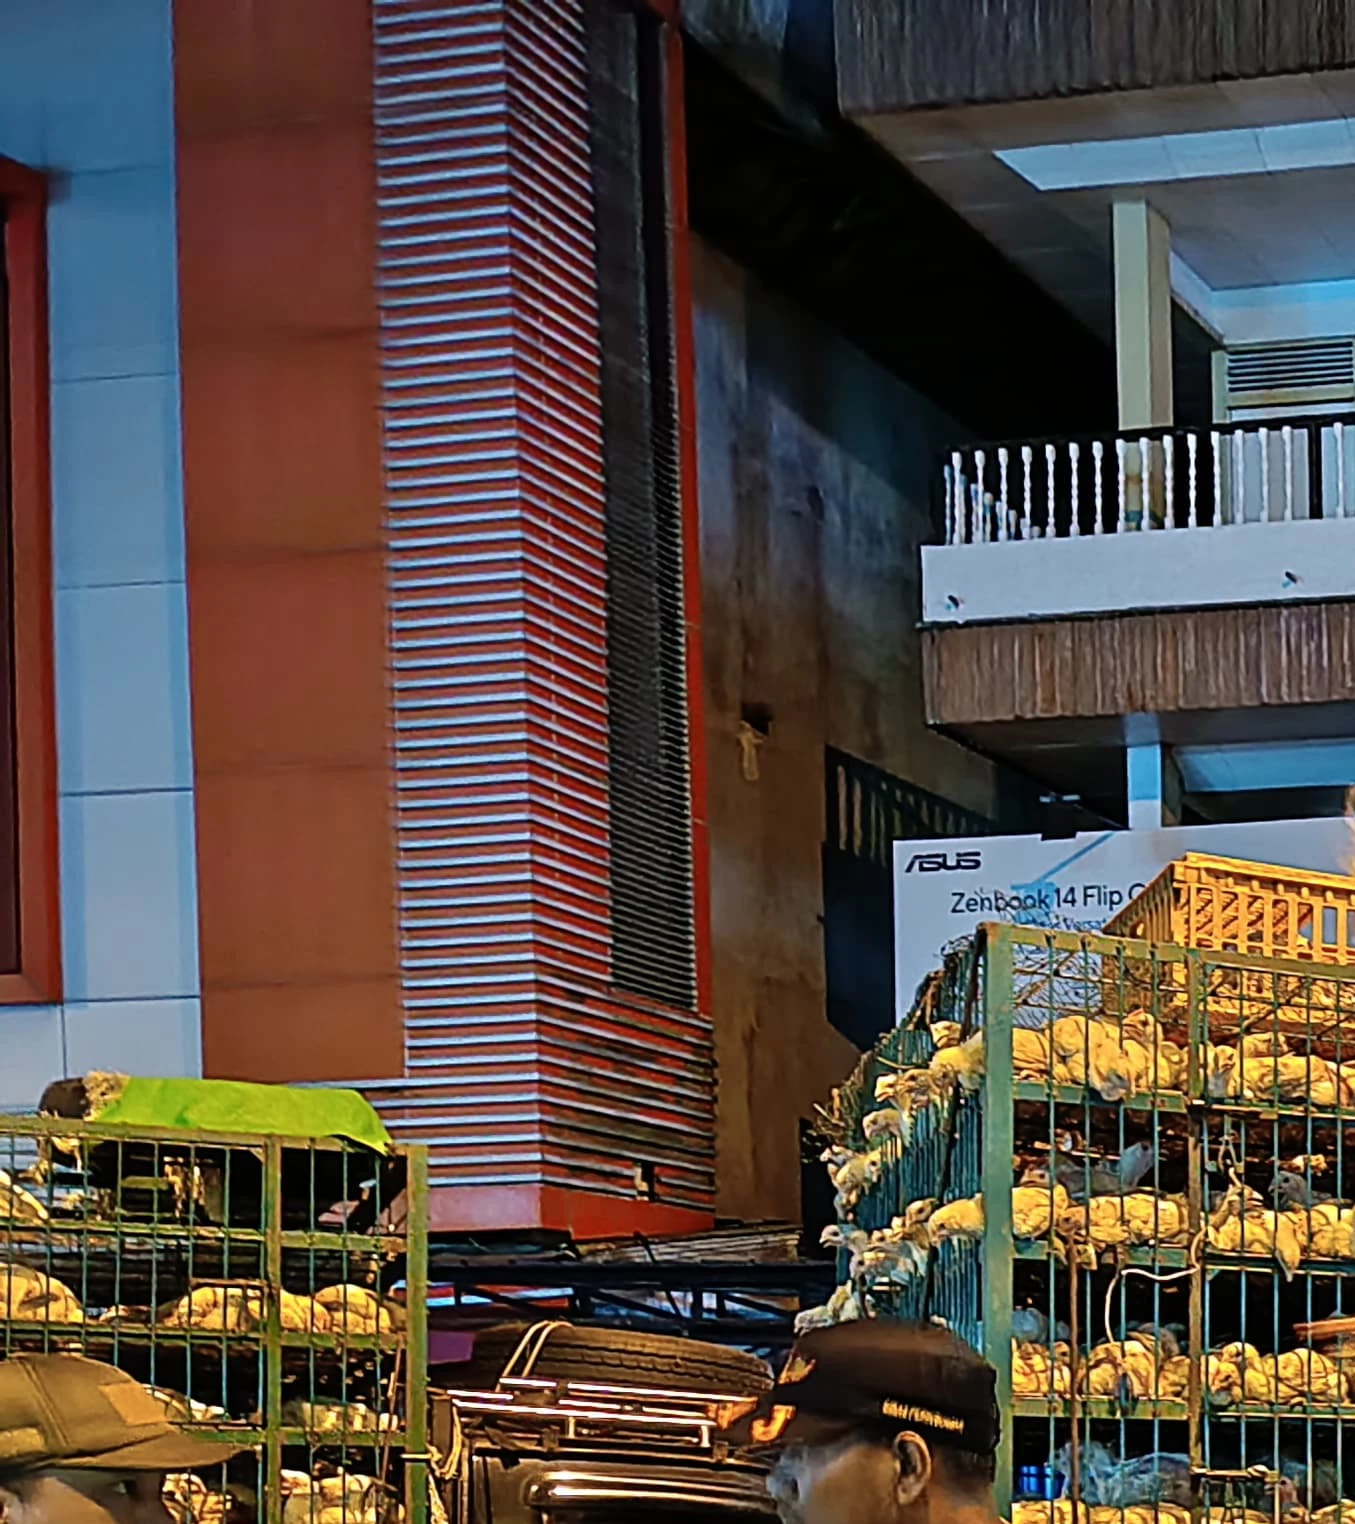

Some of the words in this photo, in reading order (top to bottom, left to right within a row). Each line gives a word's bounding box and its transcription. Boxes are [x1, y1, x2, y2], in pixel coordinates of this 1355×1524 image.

[905, 851, 982, 873] ASUS
[951, 888, 1050, 914] Zenbook
[1055, 886, 1077, 906] 14
[1083, 884, 1123, 911] Flip
